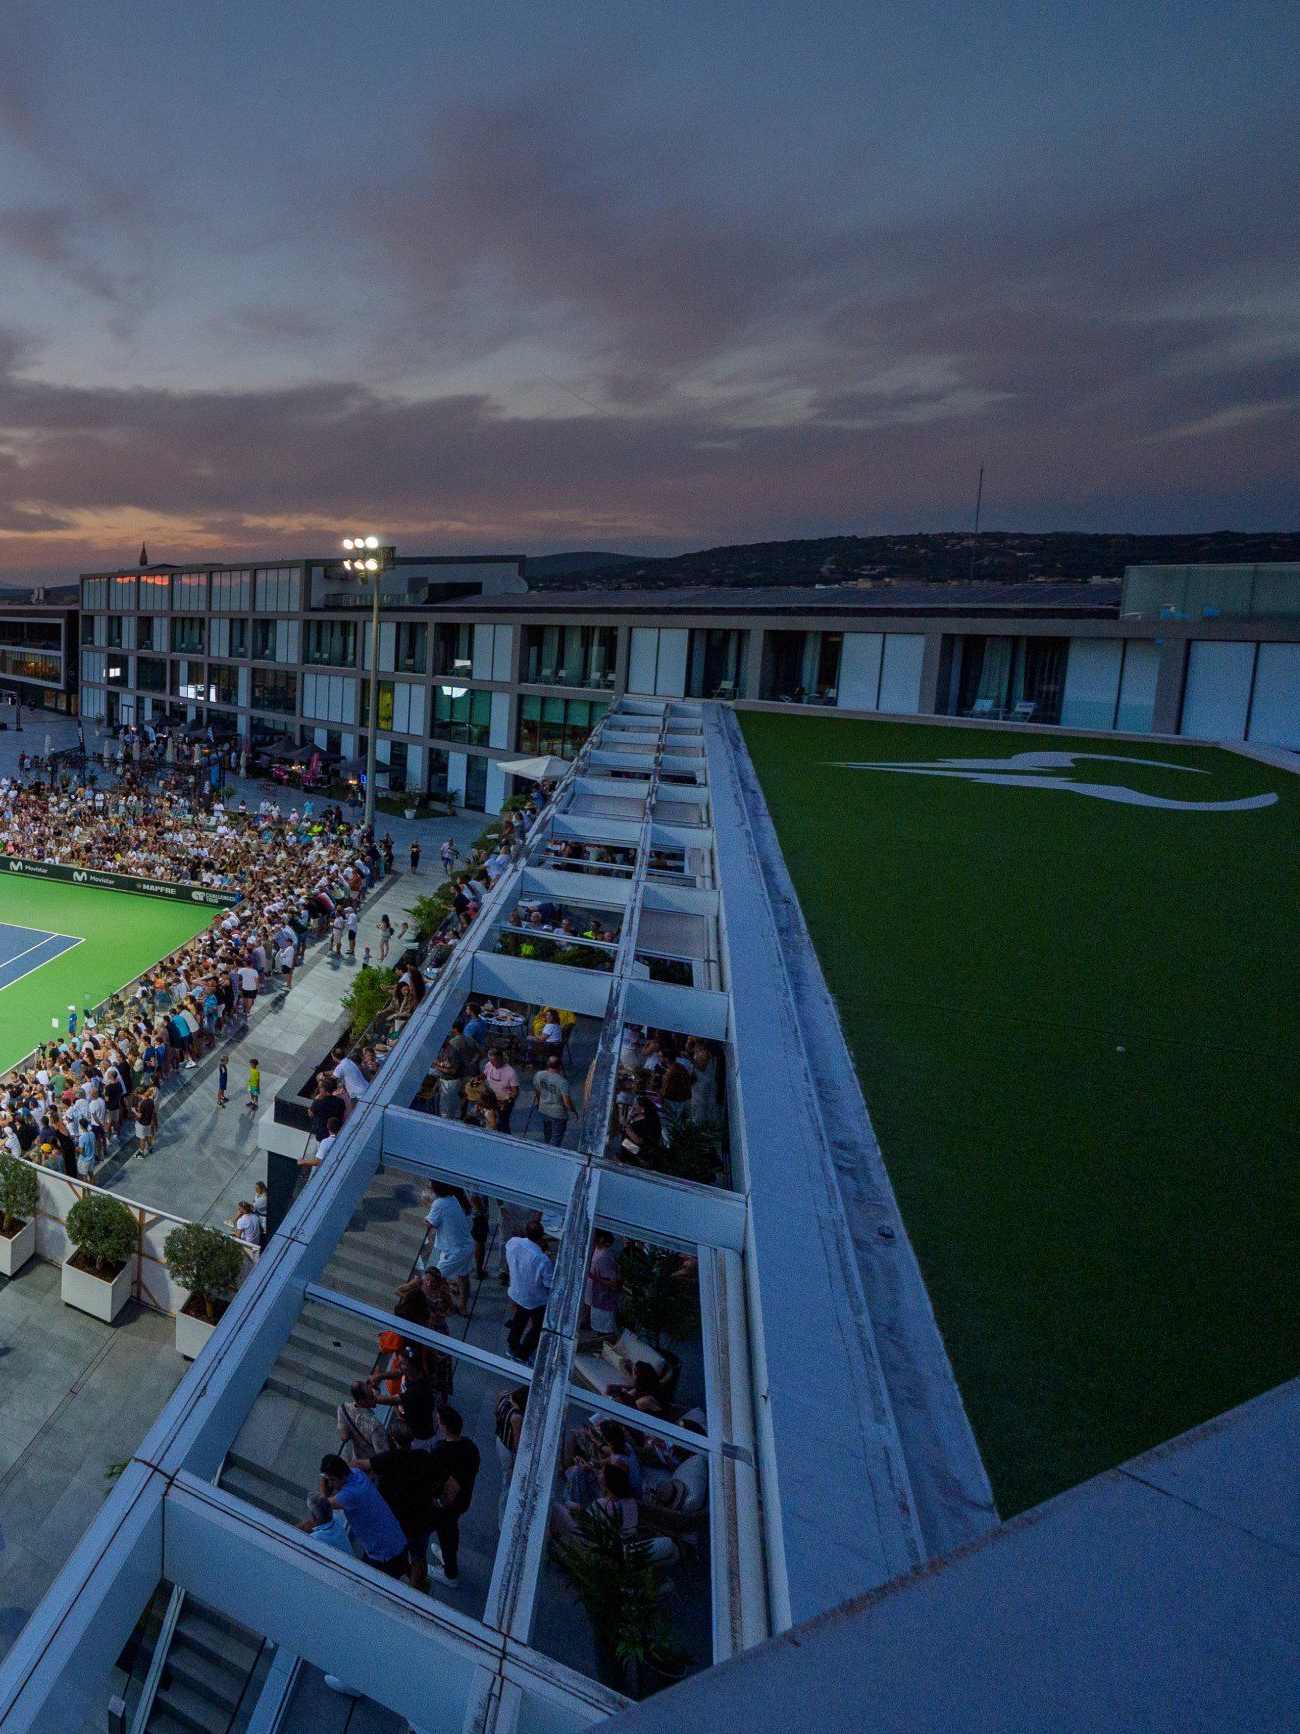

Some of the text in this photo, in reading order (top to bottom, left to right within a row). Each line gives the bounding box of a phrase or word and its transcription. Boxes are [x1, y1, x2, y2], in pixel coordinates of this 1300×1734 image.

[24, 865, 48, 874] Movistar
[90, 876, 115, 884] Movistar
[142, 884, 176, 894] MAPFRE
